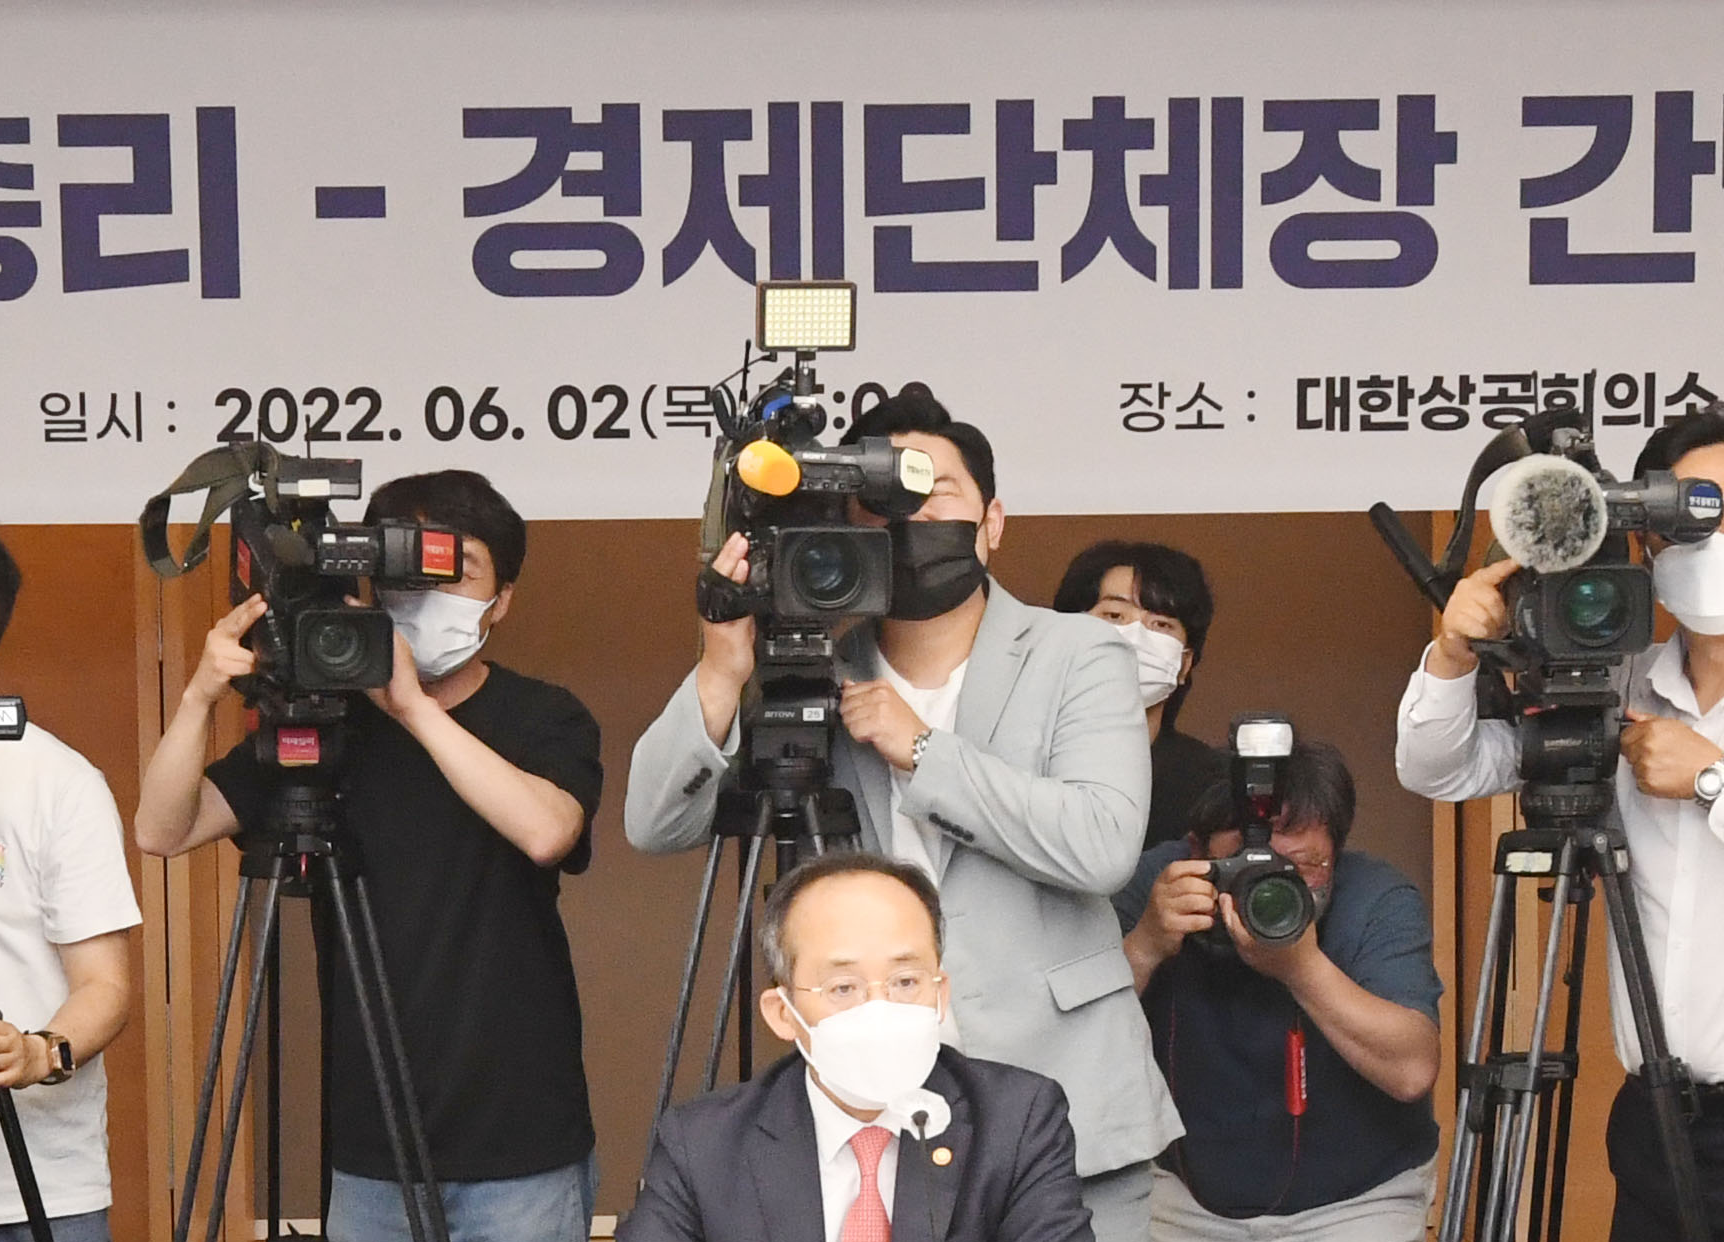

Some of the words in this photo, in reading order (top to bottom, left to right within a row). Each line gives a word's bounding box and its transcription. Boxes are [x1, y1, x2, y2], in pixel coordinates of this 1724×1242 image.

[462, 93, 1459, 298] 경제단체장
[213, 386, 403, 443] 2022.
[423, 385, 526, 442] 06.
